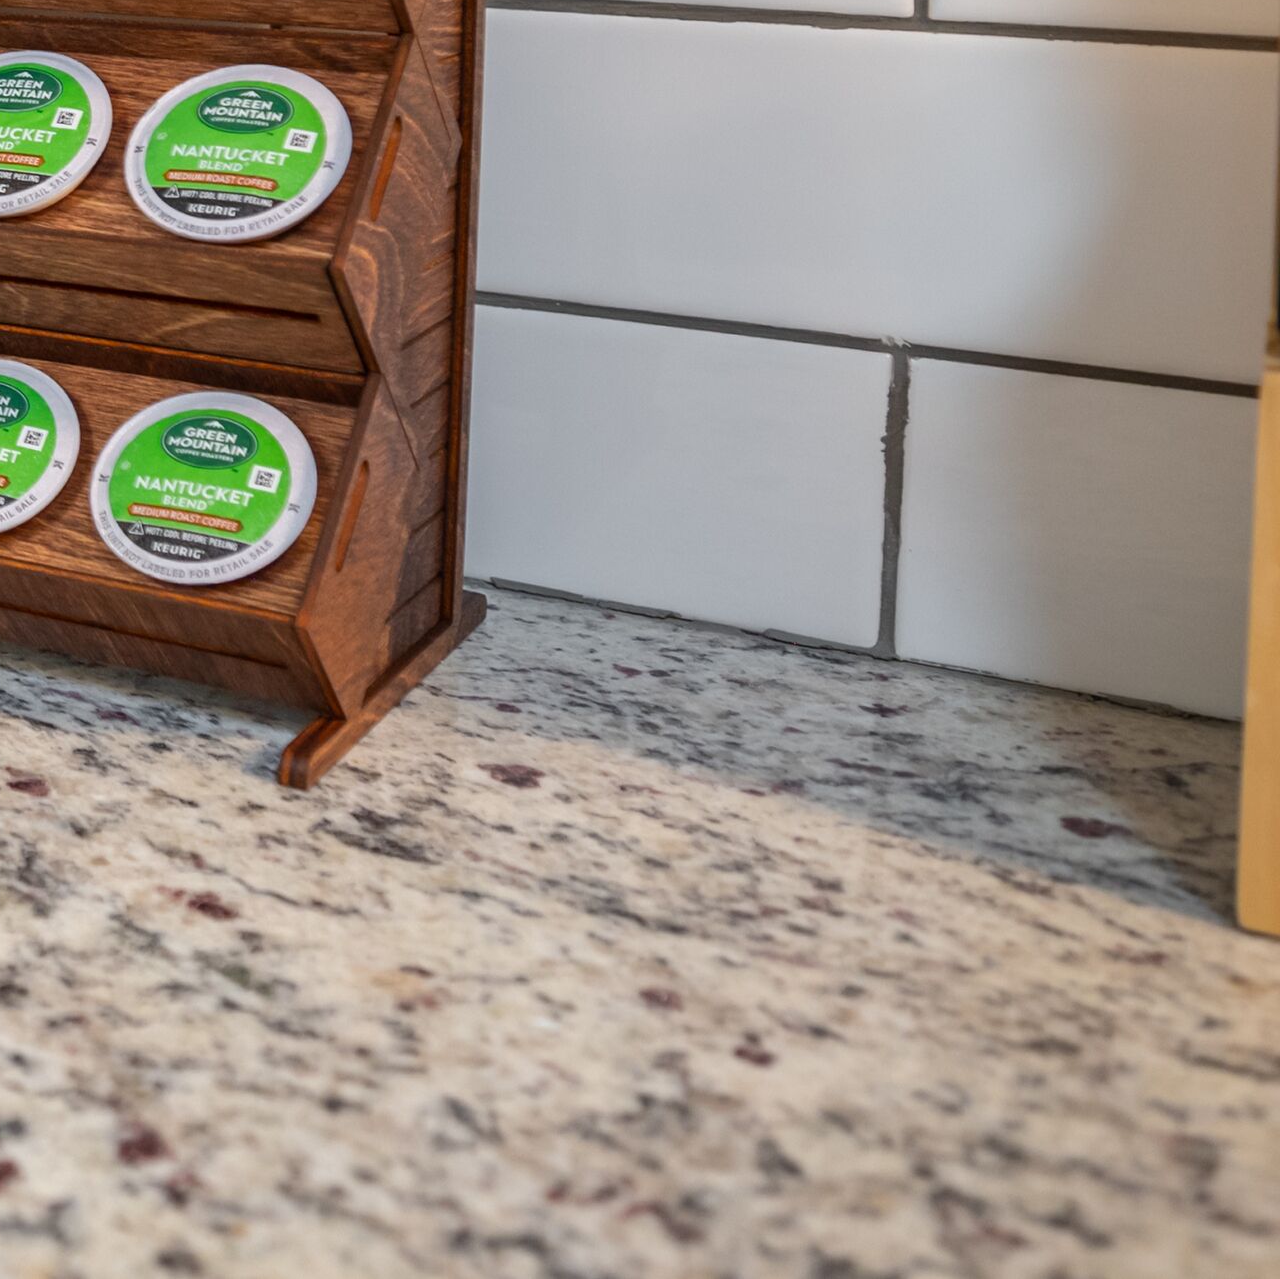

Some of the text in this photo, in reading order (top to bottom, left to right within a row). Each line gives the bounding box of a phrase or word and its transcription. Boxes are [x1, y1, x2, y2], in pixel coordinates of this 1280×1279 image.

[221, 97, 273, 110] GREEN
[203, 106, 283, 122] MOUNTAIN
[6, 155, 40, 165] COFFEE
[172, 144, 288, 166] NANTUCKET
[198, 159, 242, 172] BLEND
[17, 188, 49, 205] RETAIL
[49, 170, 72, 189] SALE
[166, 170, 273, 189] MEDIUM ROAST COFFEE
[189, 203, 236, 217] KEURIG
[185, 426, 237, 444] GREEN
[167, 435, 248, 457] MOUNTAIN
[136, 475, 253, 506] NANTUCKET
[163, 494, 207, 511] BLEND
[131, 504, 237, 531] MEDIUM ROAST COFFEE
[154, 542, 201, 559] KEURIG
